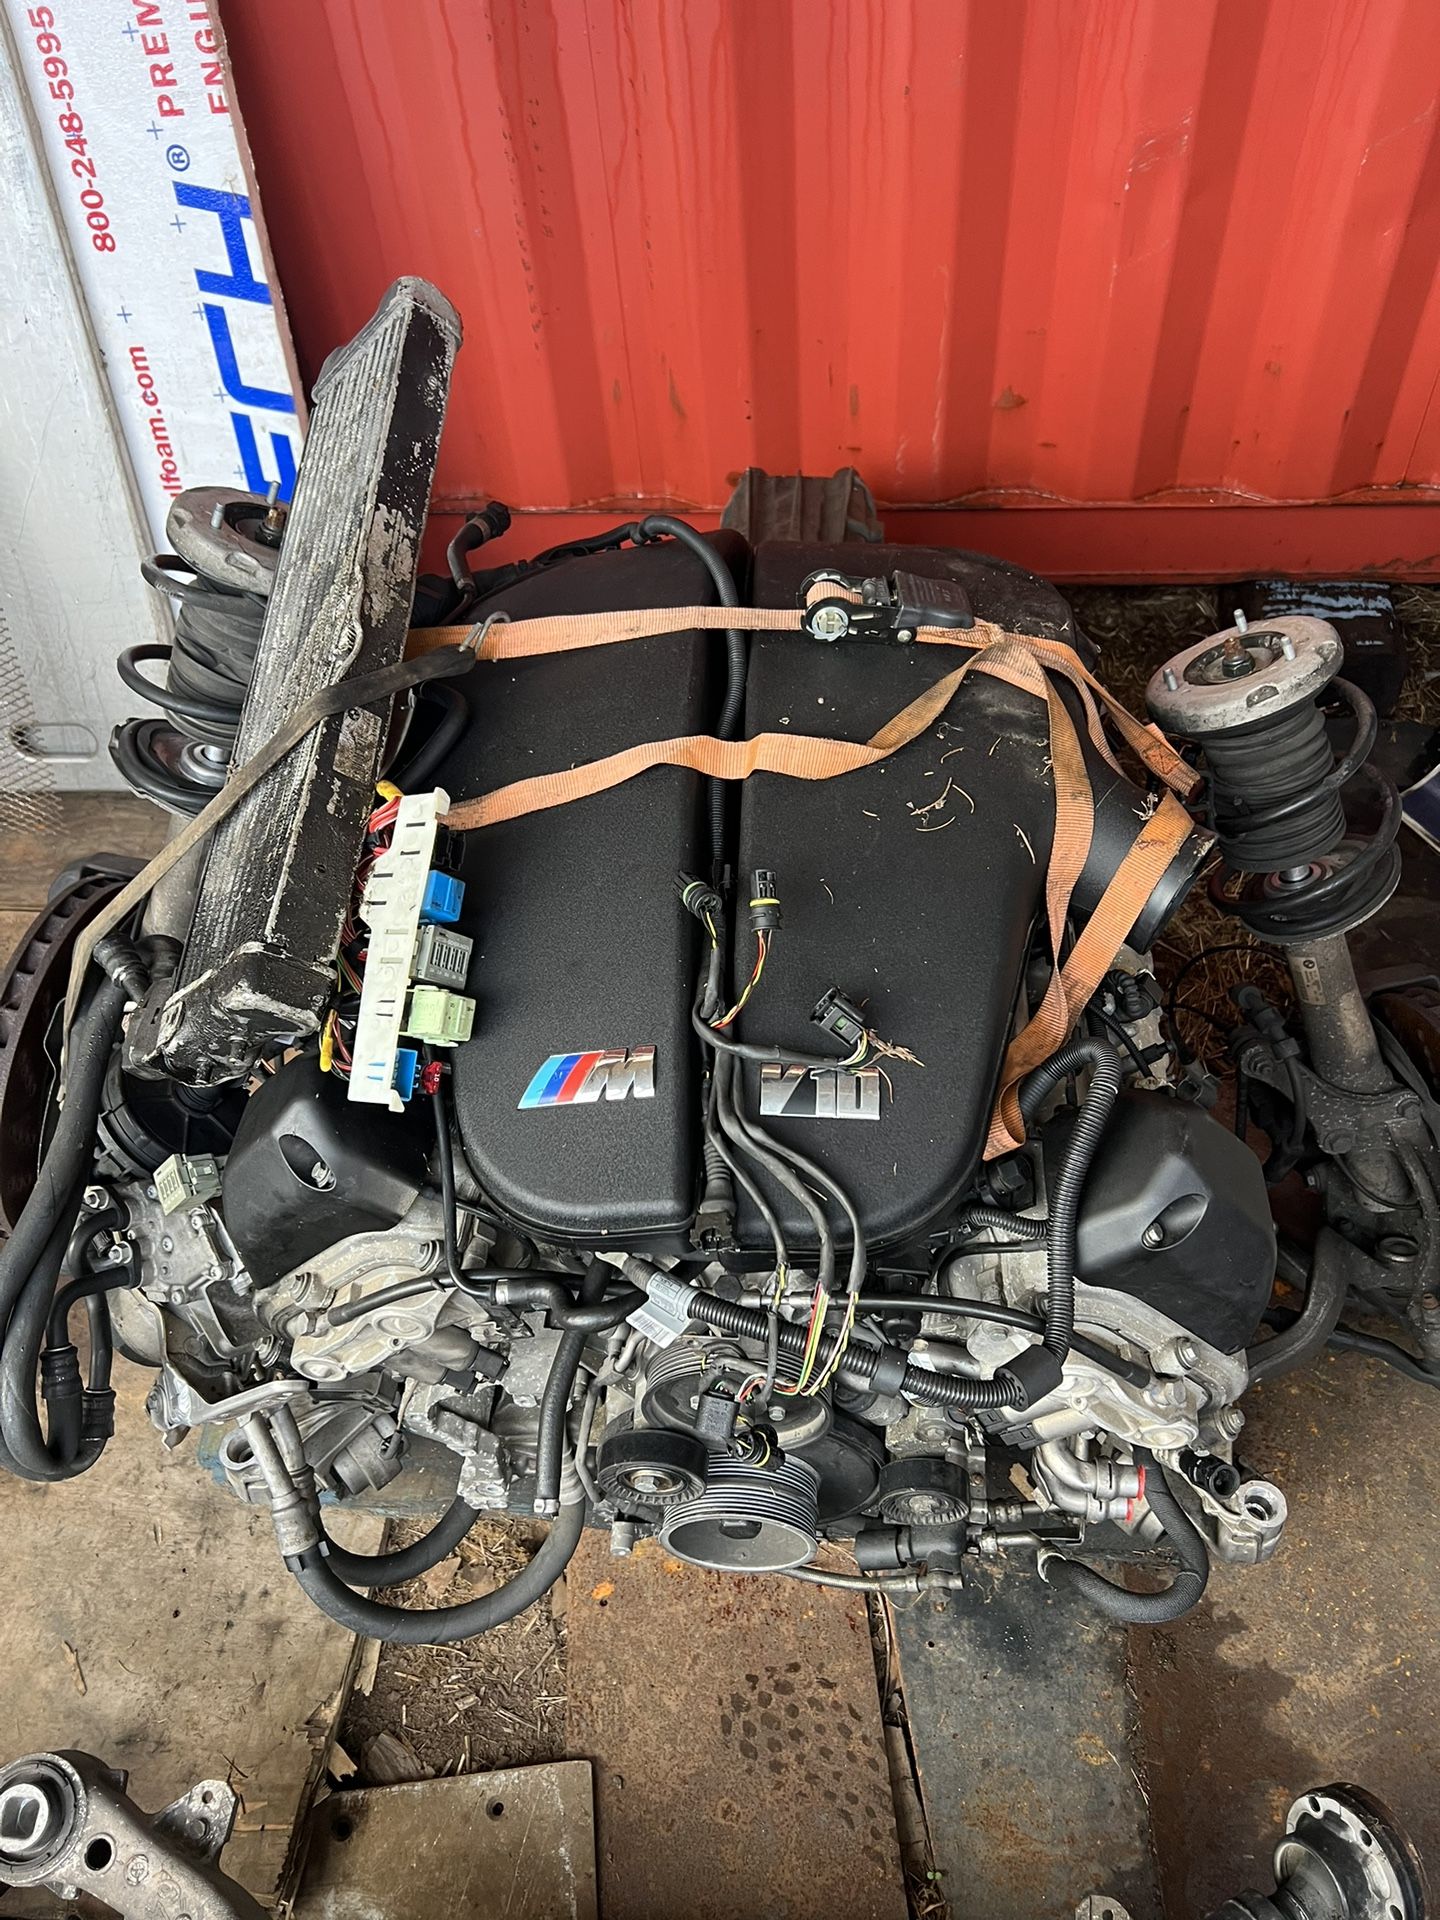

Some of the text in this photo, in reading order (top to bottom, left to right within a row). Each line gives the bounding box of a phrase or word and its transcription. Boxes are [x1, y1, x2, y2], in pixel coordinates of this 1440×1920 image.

[186, 0, 230, 114] ENGI
[27, 6, 116, 253] 800-248-5995
[128, 346, 183, 498] lfoam.com
[760, 1062, 881, 1120] V10
